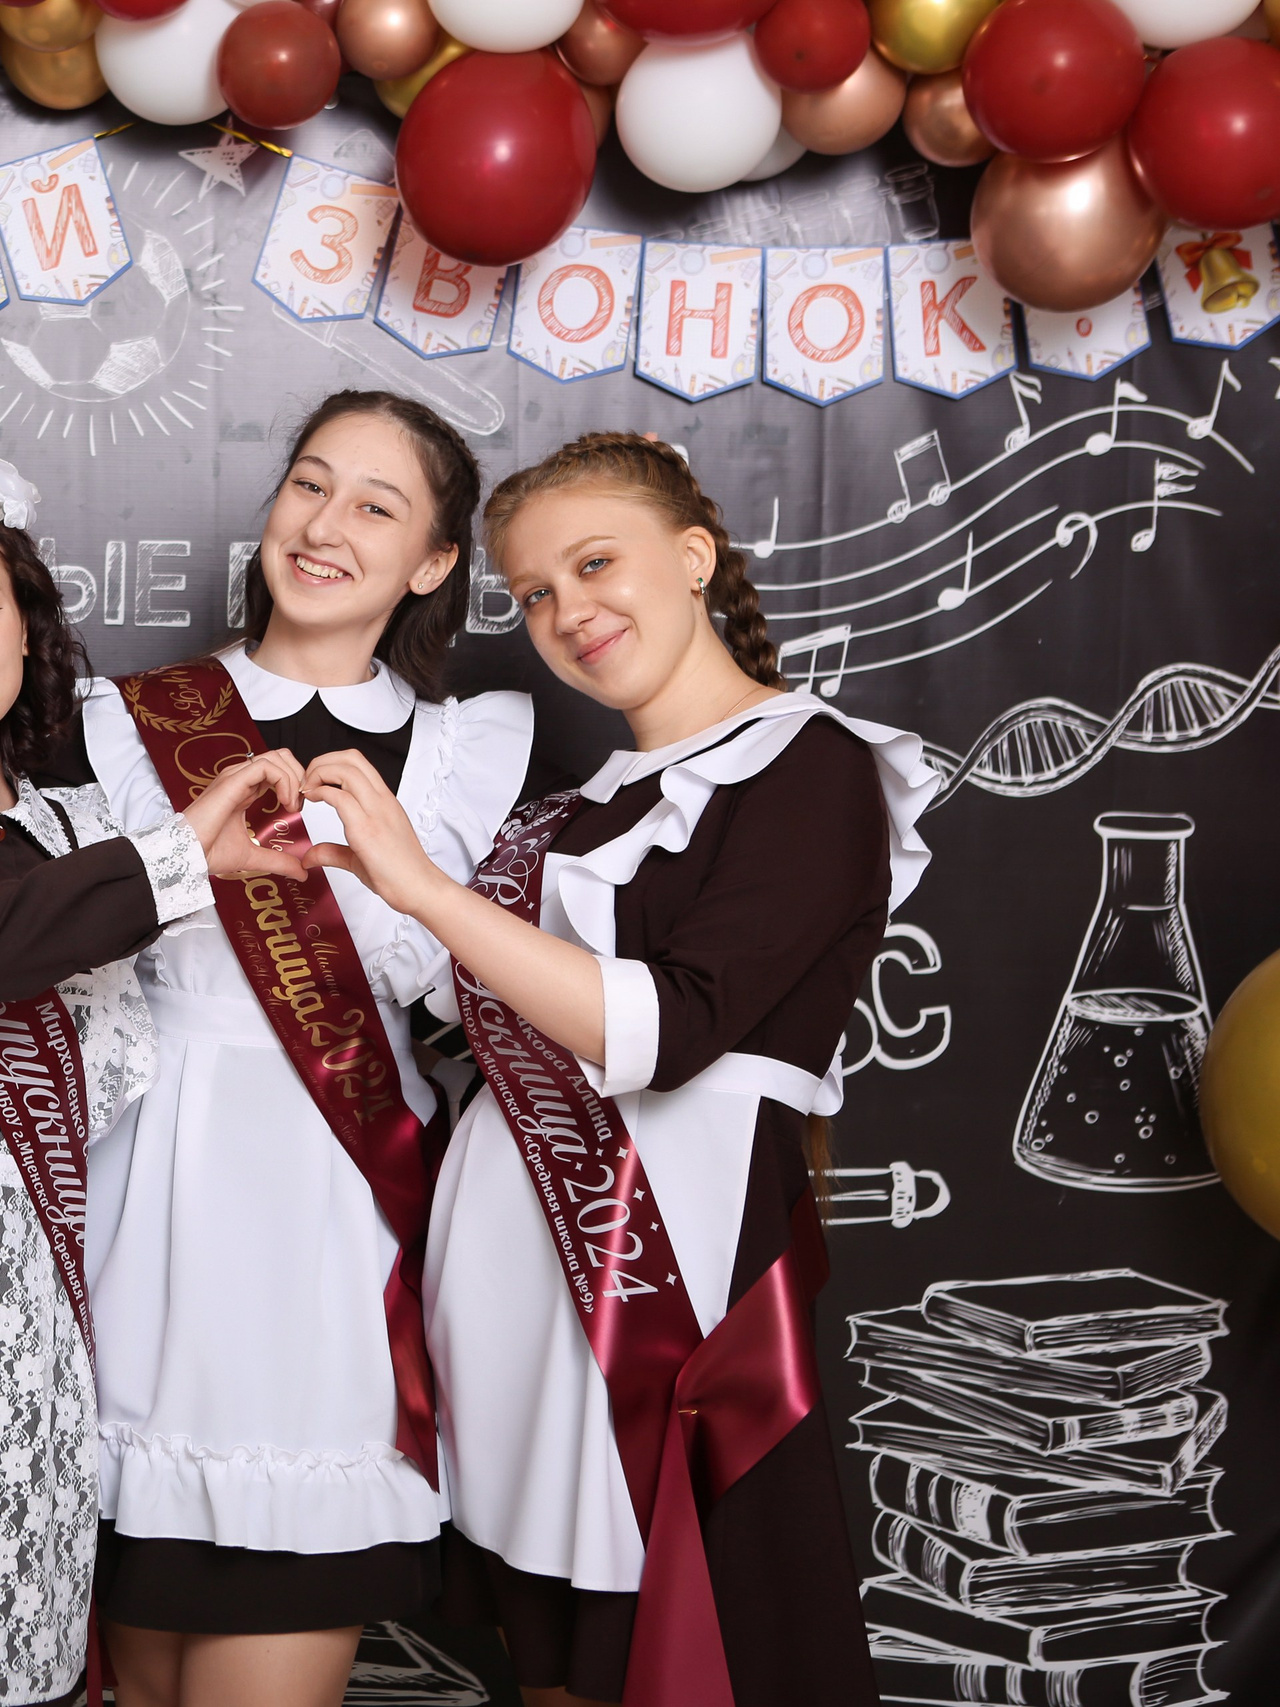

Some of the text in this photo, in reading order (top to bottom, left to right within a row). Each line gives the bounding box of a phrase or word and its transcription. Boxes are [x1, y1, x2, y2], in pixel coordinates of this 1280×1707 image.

[289, 205, 1093, 364] ЗВОНОК
[35, 1001, 86, 1138] Мирхоленко
[302, 1008, 395, 1127] 2024
[566, 1074, 613, 1143] Алина
[460, 992, 480, 1038] МБОУ
[523, 1134, 561, 1214] «Средняя
[553, 1214, 580, 1272] школа
[572, 1272, 595, 1314] №9»
[51, 1224, 84, 1301] «Средняя
[78, 1304, 92, 1352] школа
[562, 1163, 659, 1303] 2024
